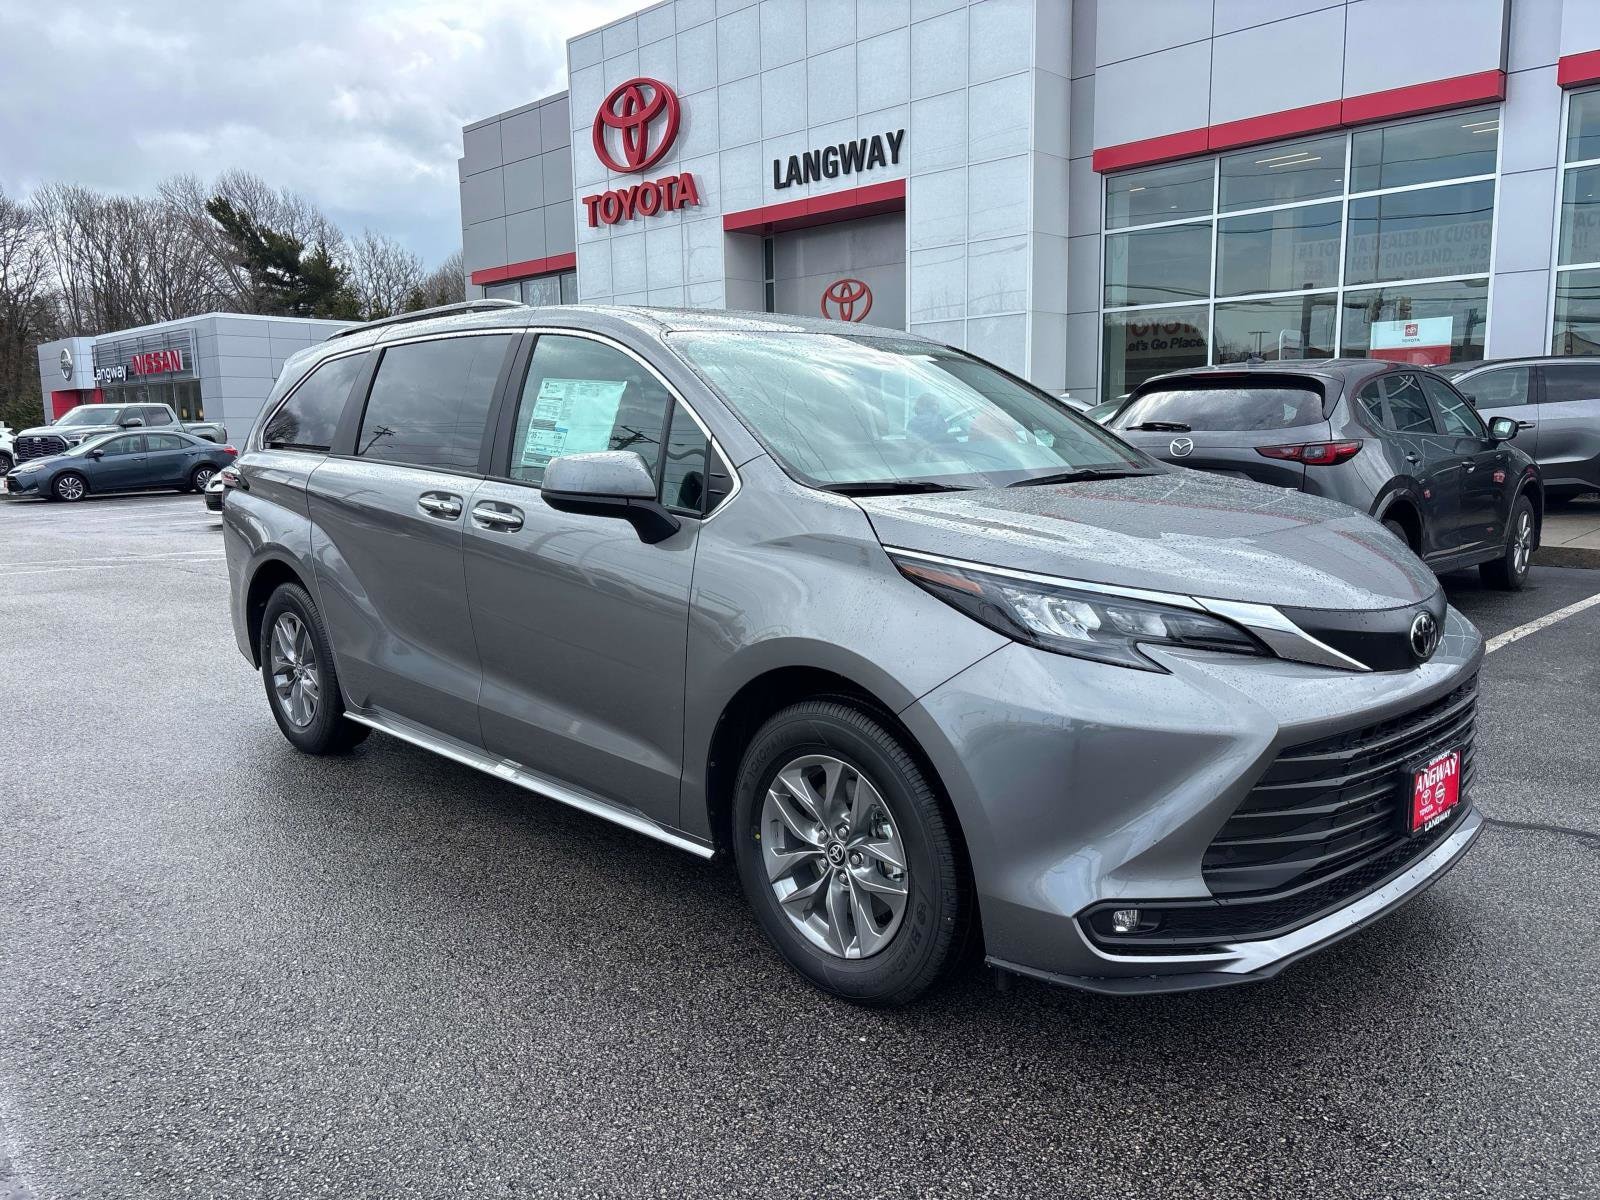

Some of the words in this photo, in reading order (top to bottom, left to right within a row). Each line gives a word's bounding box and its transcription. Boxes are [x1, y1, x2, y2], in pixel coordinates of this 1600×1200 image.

[774, 129, 905, 190] LANGWAY
[583, 172, 701, 228] TOYOTA
[1424, 227, 1441, 247] IN
[1150, 338, 1168, 350] Go
[93, 364, 128, 384] Langway
[131, 348, 184, 377] NISSAN
[1415, 757, 1457, 795] ANGWAY
[1424, 809, 1451, 832] LANGWAY
